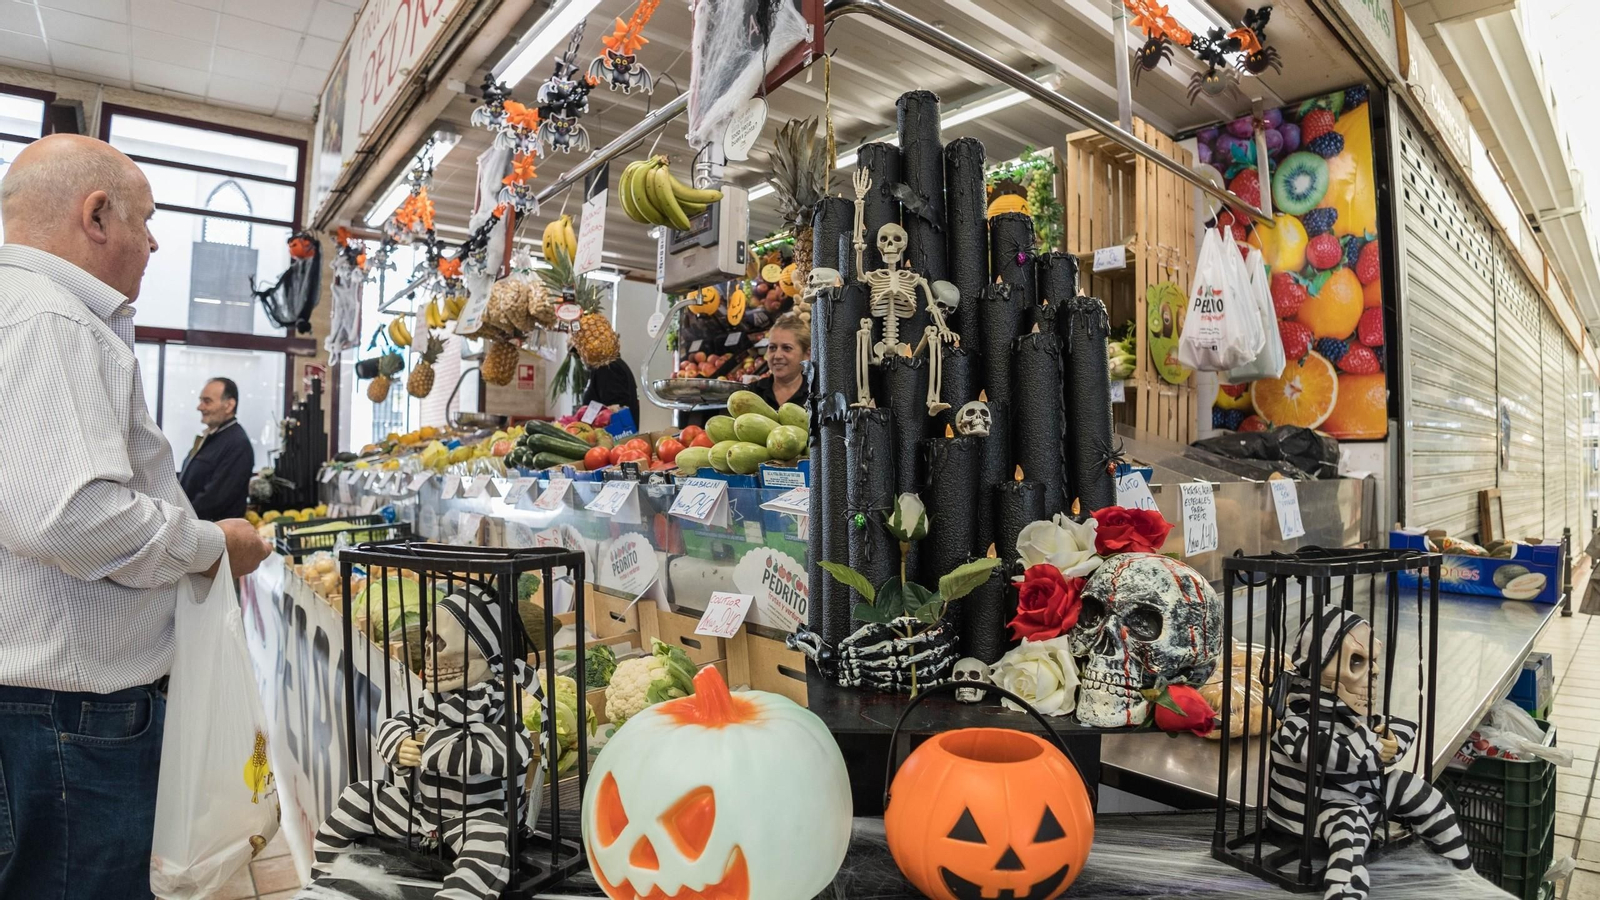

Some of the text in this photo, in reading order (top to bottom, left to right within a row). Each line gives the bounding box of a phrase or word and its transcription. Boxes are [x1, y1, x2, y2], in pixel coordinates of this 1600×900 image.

[358, 0, 443, 137] PEDR
[1116, 477, 1139, 493] NIATO
[612, 550, 638, 577] PEDRITO
[762, 568, 807, 616] PEDRITO
